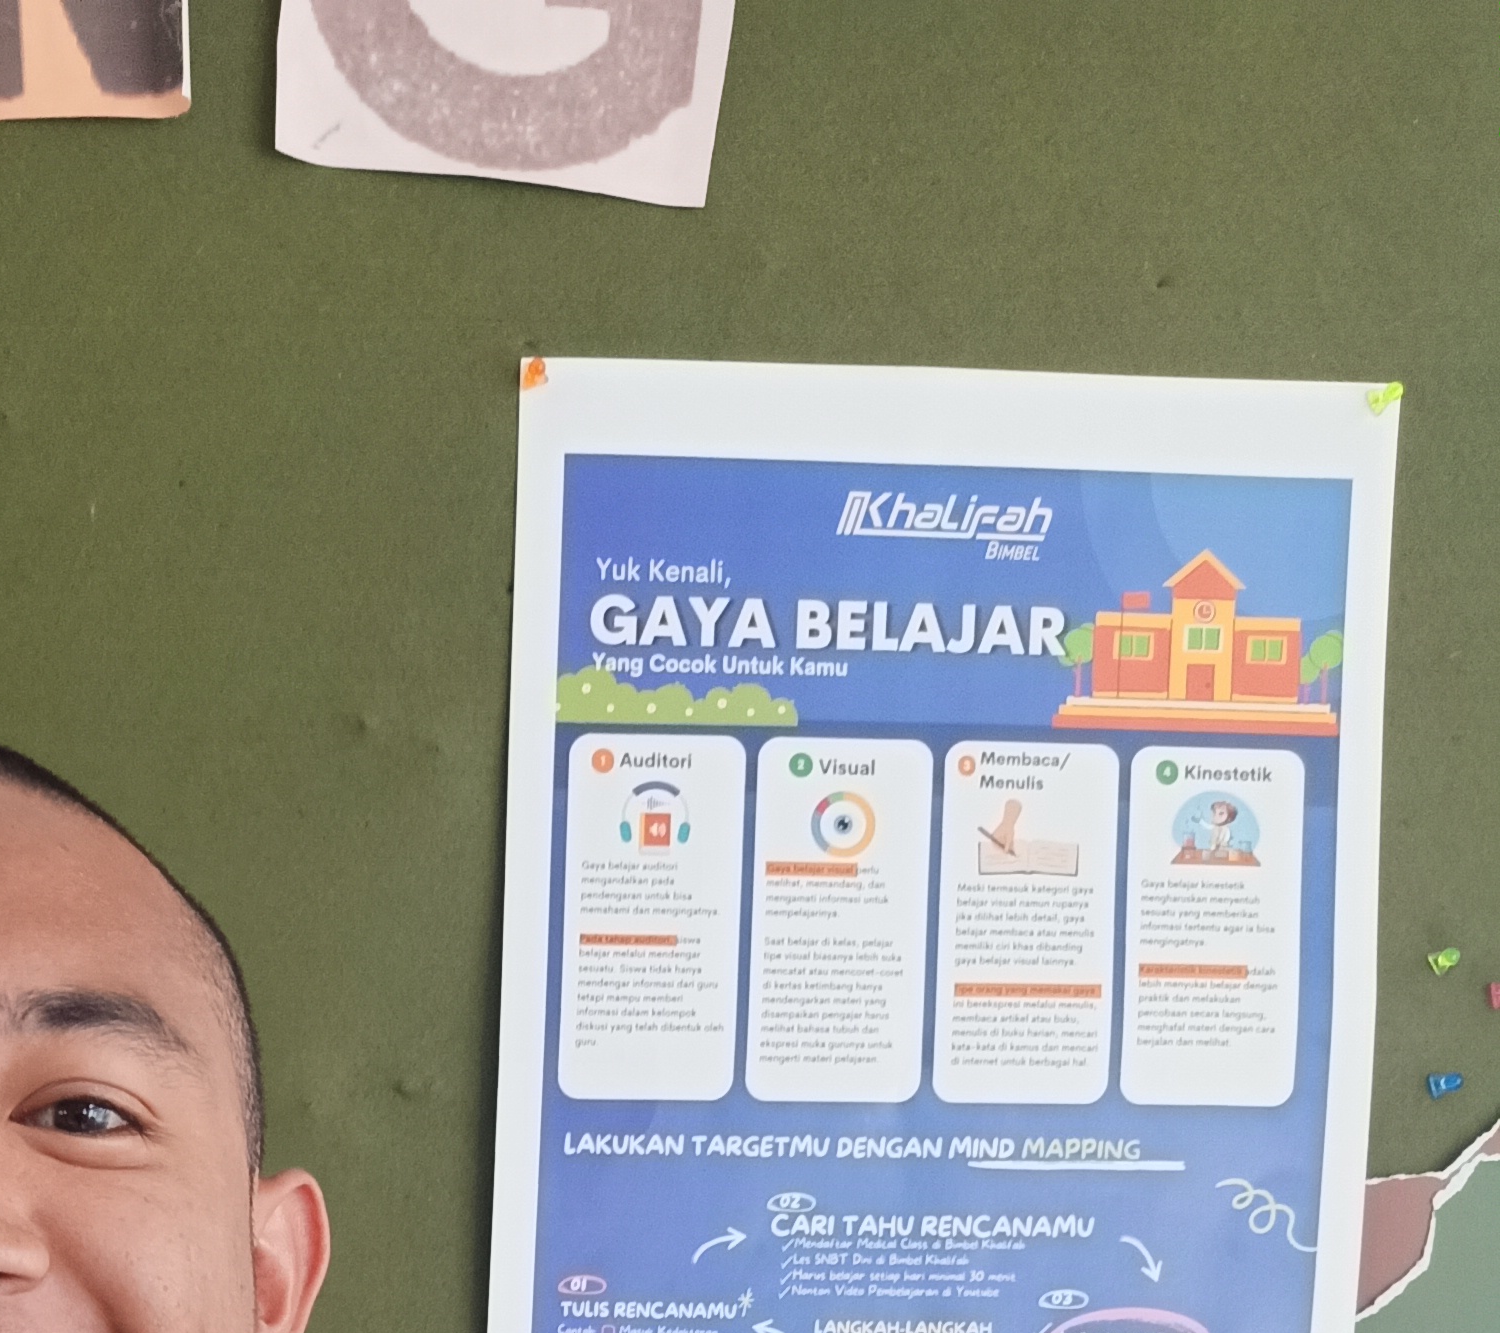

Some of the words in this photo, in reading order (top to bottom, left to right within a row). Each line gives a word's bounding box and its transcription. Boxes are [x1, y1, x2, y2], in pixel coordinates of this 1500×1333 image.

[596, 556, 640, 581] Yuk
[649, 558, 731, 588] Kenali,
[590, 594, 776, 648] GAYA
[796, 599, 1066, 656] BELAJAR
[592, 651, 643, 677] Yang
[650, 654, 716, 673] Cocok
[722, 654, 784, 675] Untuk
[790, 656, 848, 677] Kamu
[619, 752, 692, 769] Auditori
[819, 759, 876, 776] Visual
[980, 751, 1071, 771] Membaca/
[979, 774, 1044, 790] Menulis
[1184, 765, 1272, 783] Kinestetik
[563, 1132, 685, 1156] LAKUKAN
[691, 1134, 830, 1158] TARGETMU
[836, 1136, 943, 1159] DENGAN
[948, 1136, 1015, 1159] MIND
[1021, 1137, 1141, 1160] MAPPING
[779, 1194, 800, 1208] 02
[771, 1214, 835, 1237] CARI
[842, 1215, 914, 1238] TAHU
[921, 1215, 1095, 1239] RENCANAMU
[793, 1254, 811, 1265] Les
[814, 1254, 847, 1266] SNBT
[791, 1269, 826, 1281] Harus
[829, 1270, 865, 1284] belajar
[969, 1271, 985, 1283] 30
[835, 1285, 865, 1297] Video
[1051, 1293, 1072, 1305] 03
[560, 1301, 609, 1318] TULIS
[614, 1301, 738, 1319] RENCANAMU
